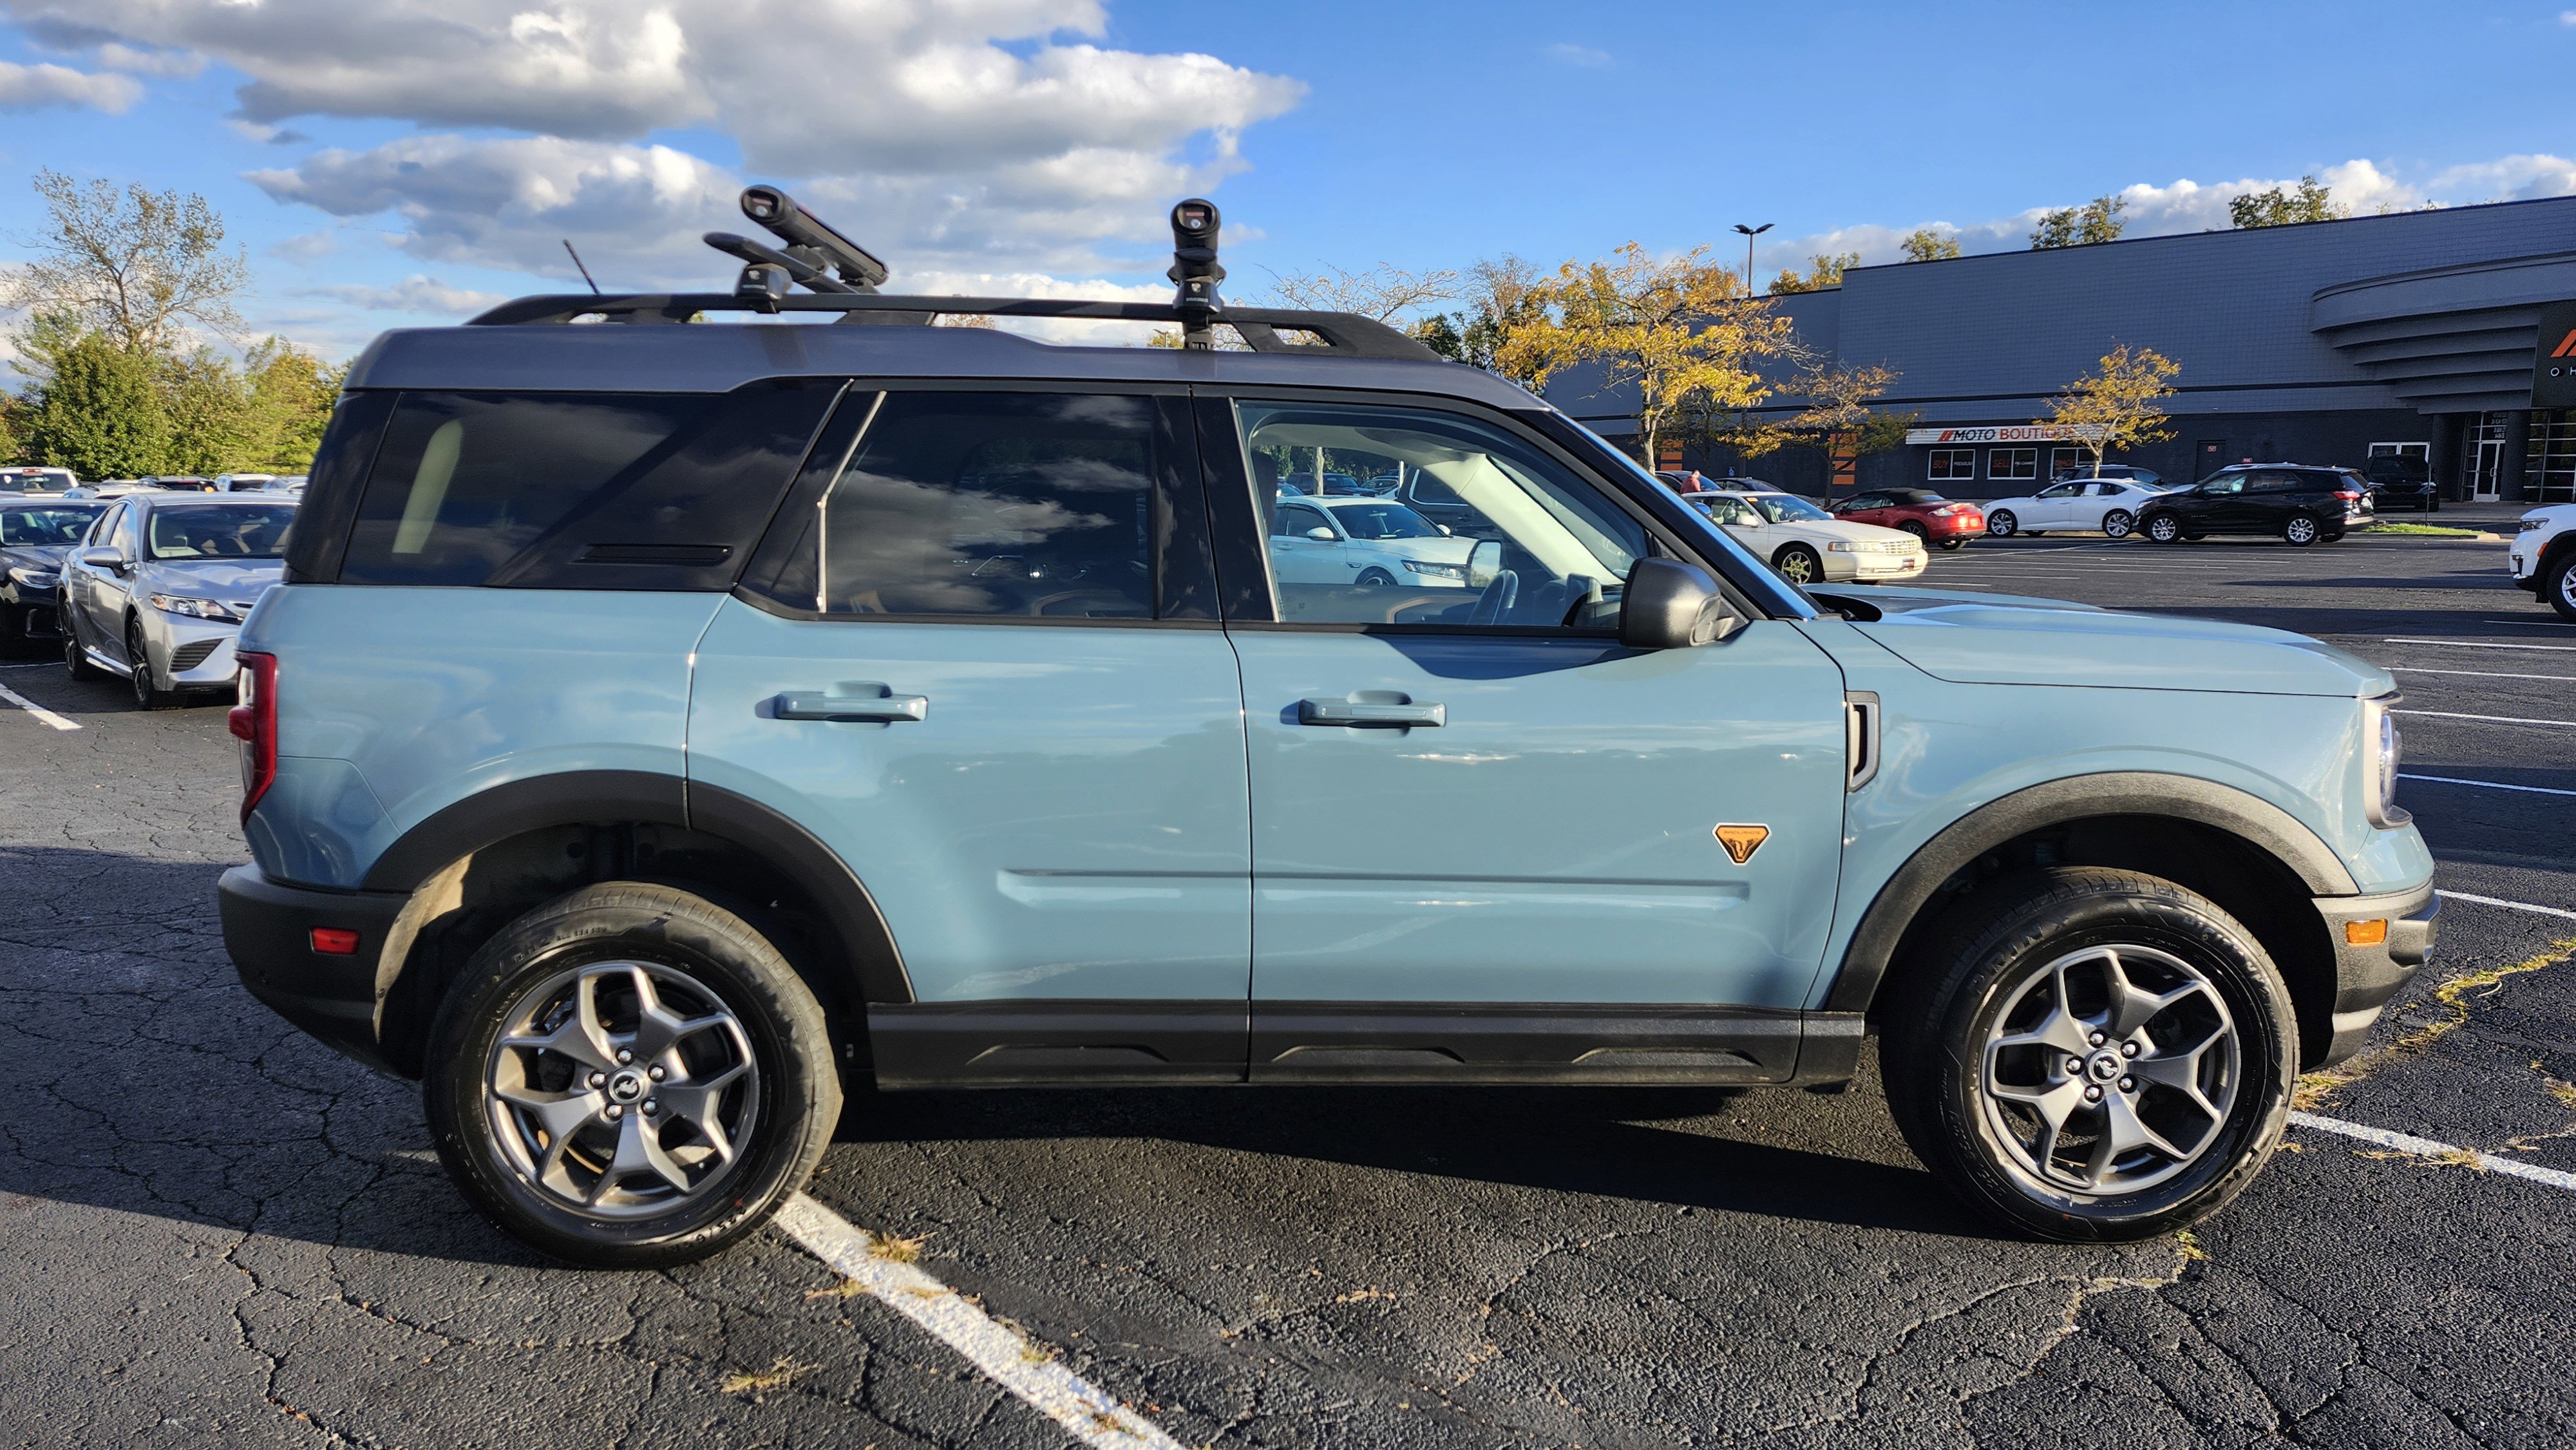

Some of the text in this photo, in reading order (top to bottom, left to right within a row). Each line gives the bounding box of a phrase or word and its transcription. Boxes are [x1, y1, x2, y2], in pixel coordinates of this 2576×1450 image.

[1953, 429, 1996, 441] MOTO
[1933, 460, 1949, 469] BUY
[1993, 458, 2010, 468] SELL
